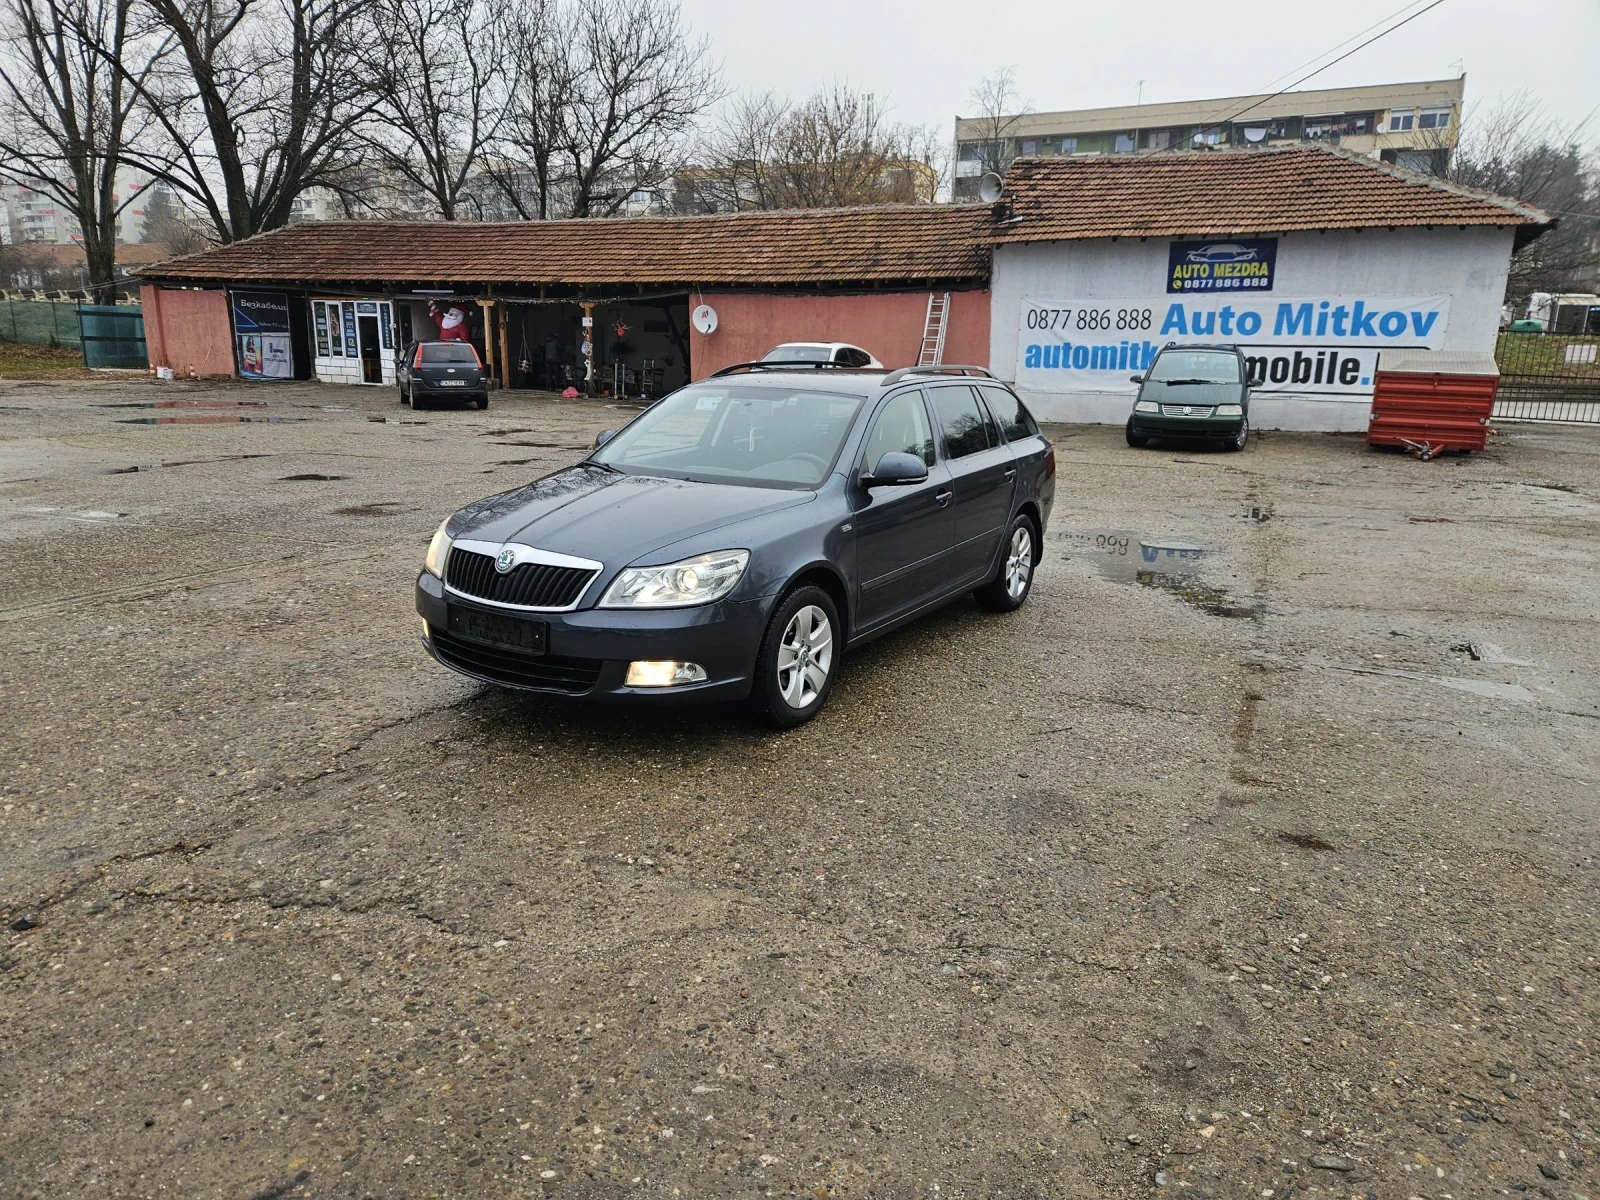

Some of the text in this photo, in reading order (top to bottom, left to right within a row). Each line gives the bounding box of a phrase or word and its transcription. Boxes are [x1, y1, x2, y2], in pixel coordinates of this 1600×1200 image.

[1173, 262, 1269, 278] AUTO MEZDRA
[1184, 277, 1269, 289] 0877 886 888
[1027, 308, 1152, 330] 0877 886 888
[1159, 301, 1440, 337] Auto Mitkov
